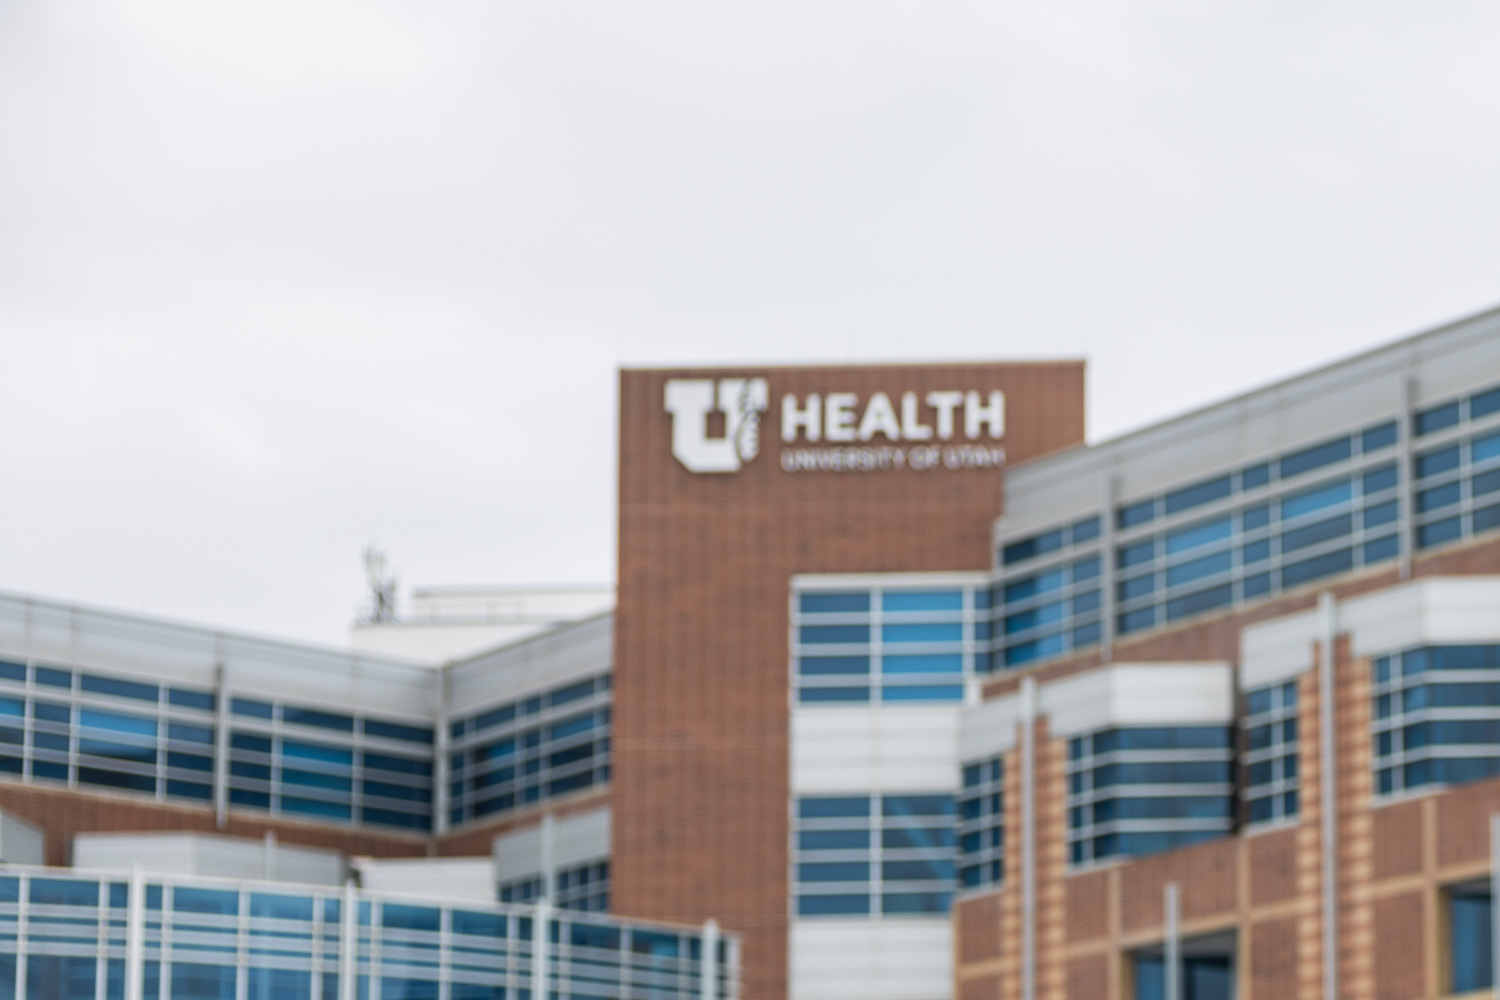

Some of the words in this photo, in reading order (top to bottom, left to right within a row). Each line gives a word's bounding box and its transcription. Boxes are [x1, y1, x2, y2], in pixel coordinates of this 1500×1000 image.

[781, 390, 1006, 442] HEALTH
[780, 446, 905, 473] UNIVERSITY
[908, 445, 941, 471] OF
[943, 444, 1006, 470] UTAH
